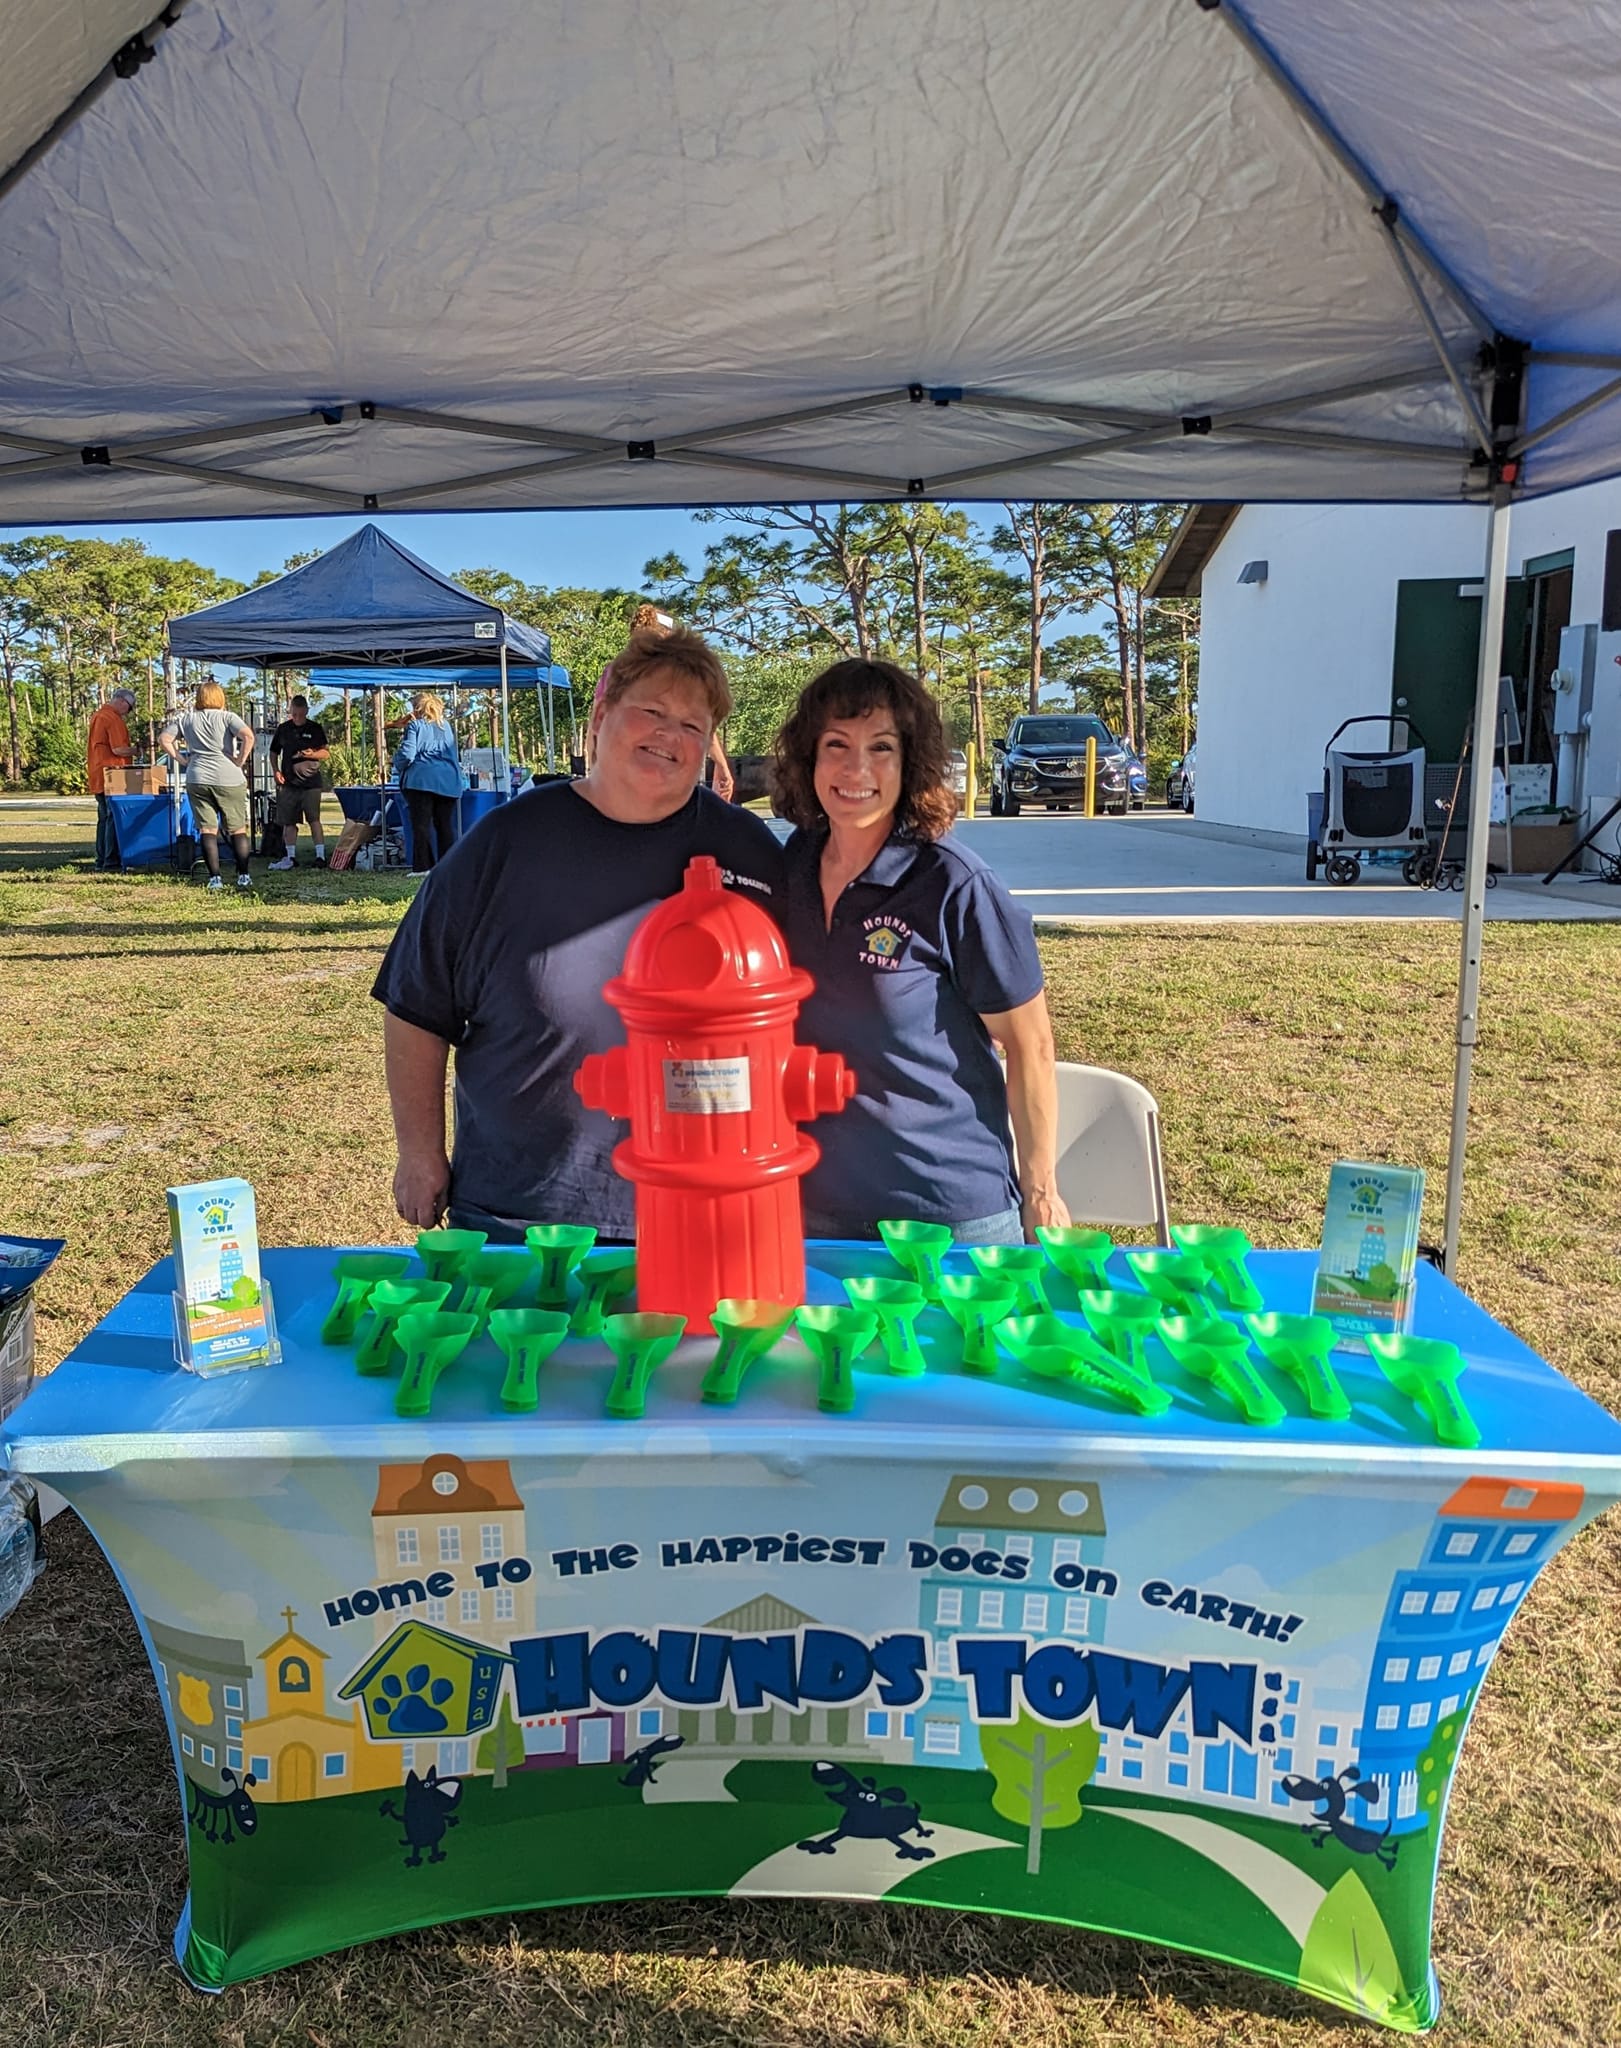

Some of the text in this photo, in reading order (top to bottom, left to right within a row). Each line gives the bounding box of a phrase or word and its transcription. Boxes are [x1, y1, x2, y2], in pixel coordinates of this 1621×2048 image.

[863, 915, 912, 938] HOUNDS
[859, 952, 900, 969] TOWN
[197, 1198, 235, 1213] HOUNDS
[203, 1224, 233, 1235] TOWN
[475, 1557, 532, 1589] TO
[908, 1541, 1030, 1580] DOGS
[472, 1665, 492, 1721] usa
[510, 1629, 1258, 1746] HOUNDS TOWN
